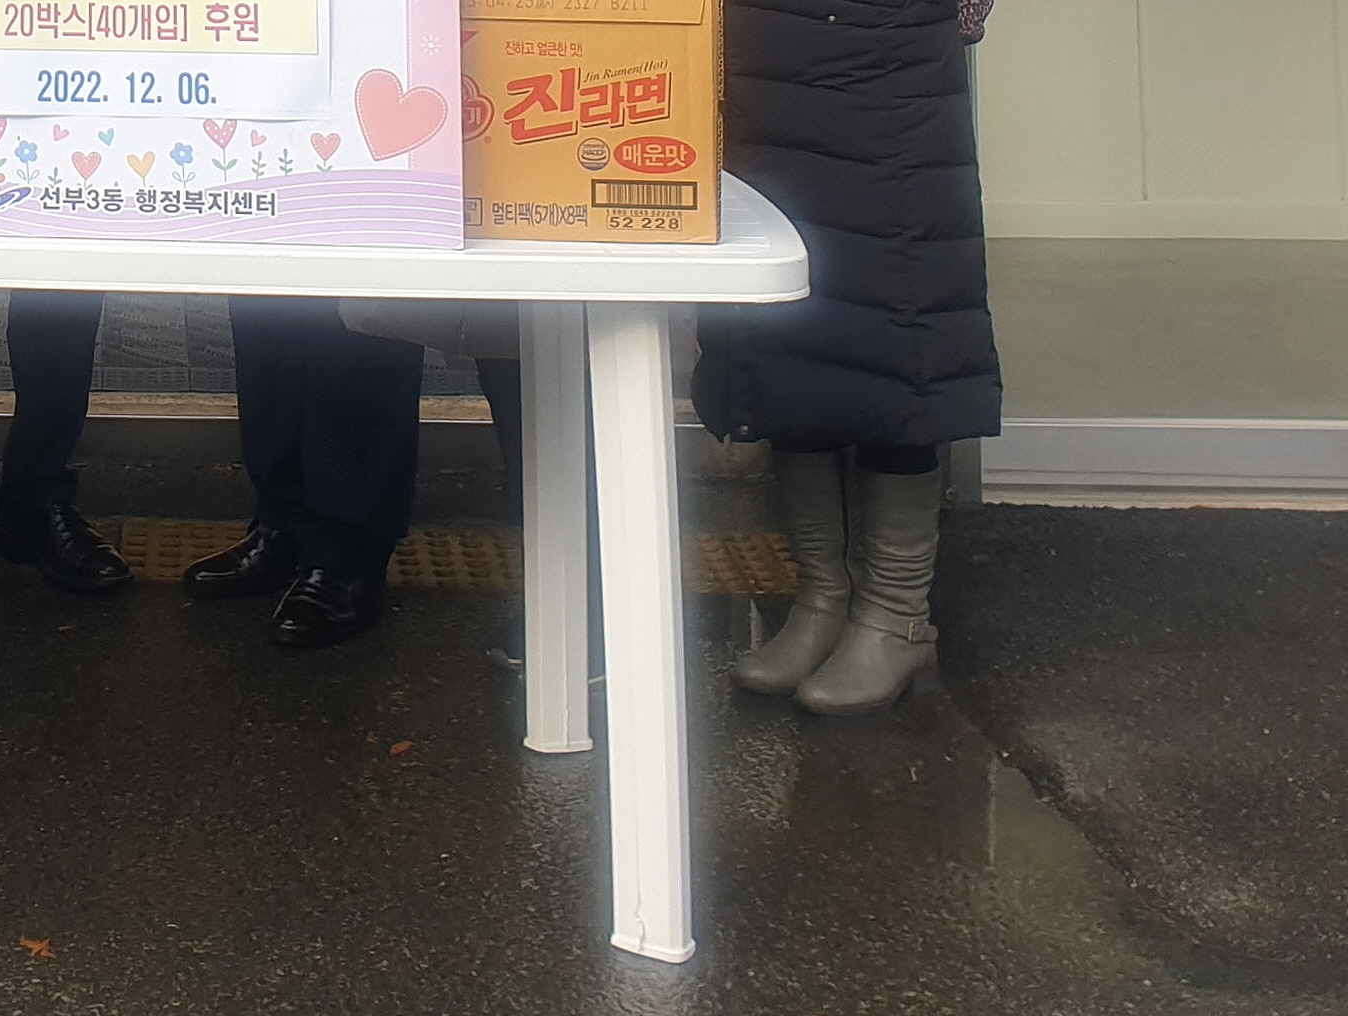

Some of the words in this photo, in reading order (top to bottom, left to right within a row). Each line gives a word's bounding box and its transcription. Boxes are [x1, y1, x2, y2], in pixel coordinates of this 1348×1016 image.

[4, 2, 190, 43] 20박스[40개입]
[203, 2, 261, 43] 후원
[504, 40, 535, 56] 진하고
[537, 41, 568, 57] 얼큰한
[37, 70, 109, 104] 2022.
[125, 72, 163, 105] 12.
[177, 73, 218, 106] 06.
[583, 71, 601, 83] Jin
[503, 67, 672, 145] 진라면
[621, 143, 688, 167] 매운맛
[39, 187, 125, 213] 선부3동
[135, 189, 278, 217] 행정복지센터
[609, 216, 634, 228] 52
[641, 217, 680, 230] 228
